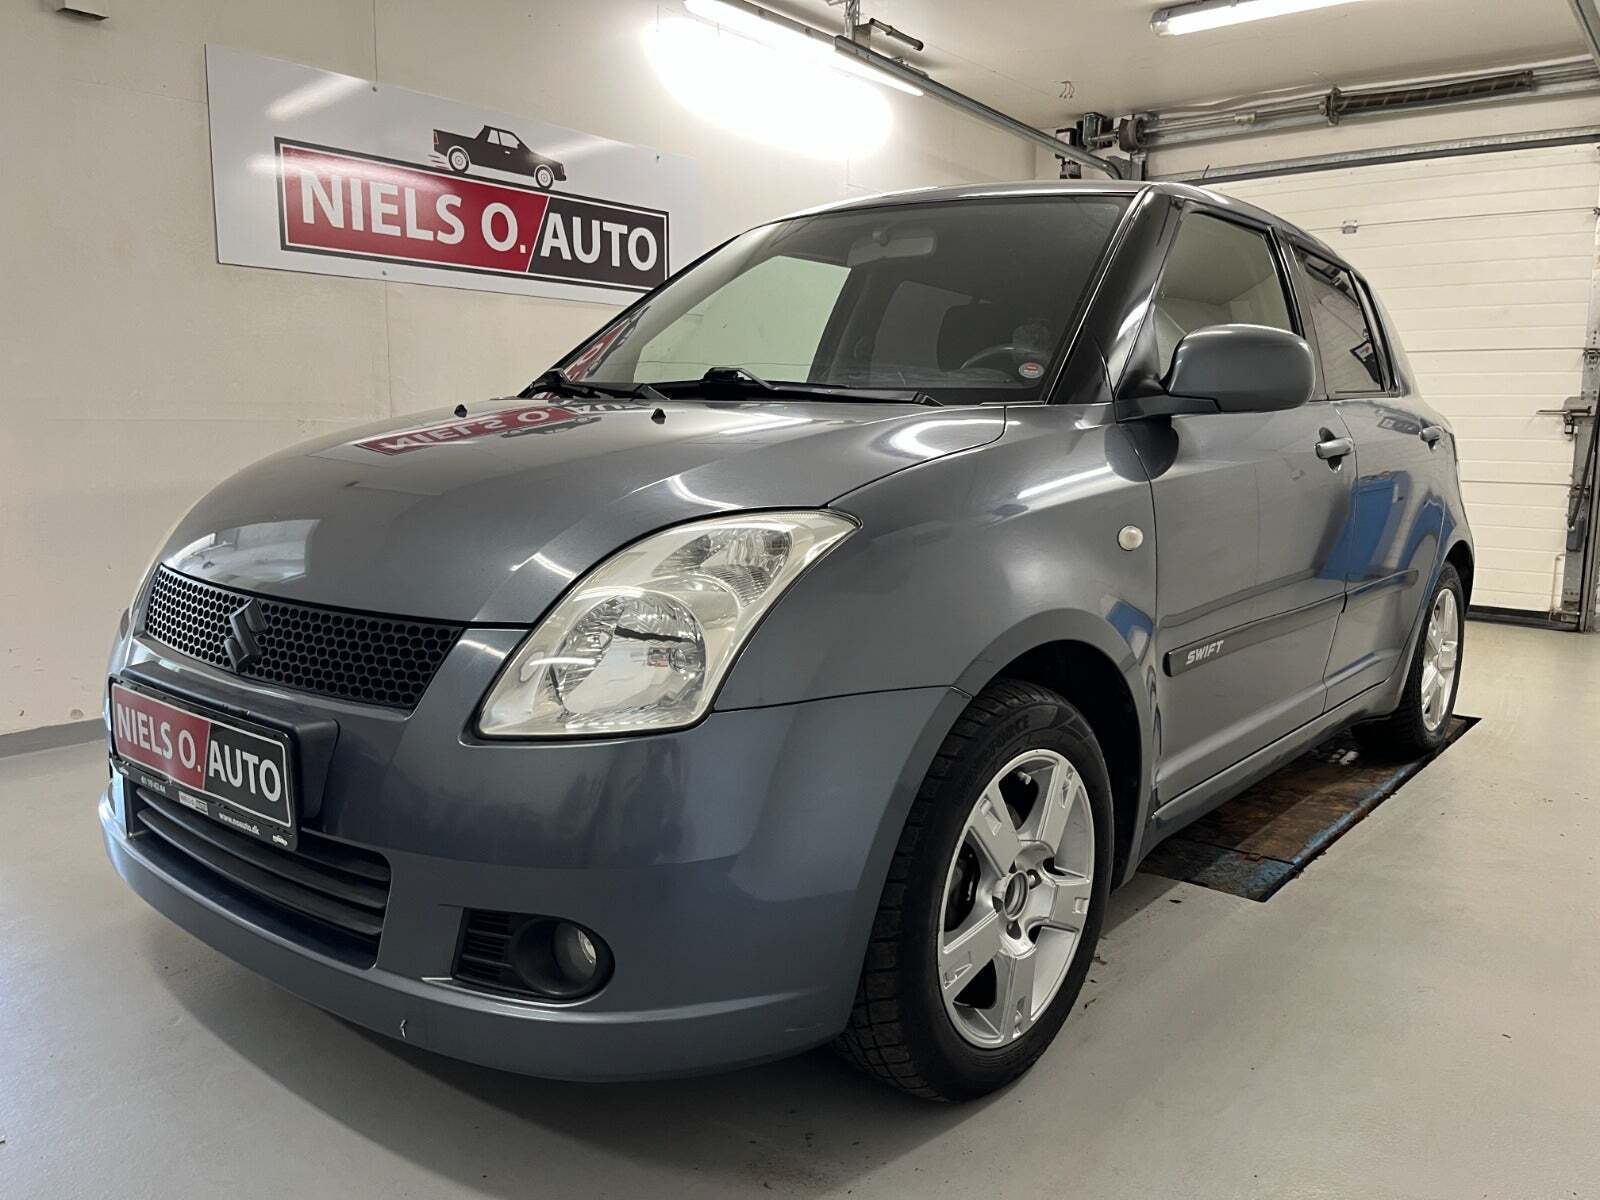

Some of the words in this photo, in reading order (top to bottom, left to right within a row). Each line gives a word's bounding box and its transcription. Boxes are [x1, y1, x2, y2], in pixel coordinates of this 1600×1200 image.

[299, 168, 466, 246] NIELS
[480, 201, 528, 254] O.
[540, 212, 659, 272] AUTO
[1185, 640, 1225, 665] SWIFT
[116, 703, 174, 760] NIELS
[178, 729, 202, 773] O.
[208, 740, 283, 802] AUTO
